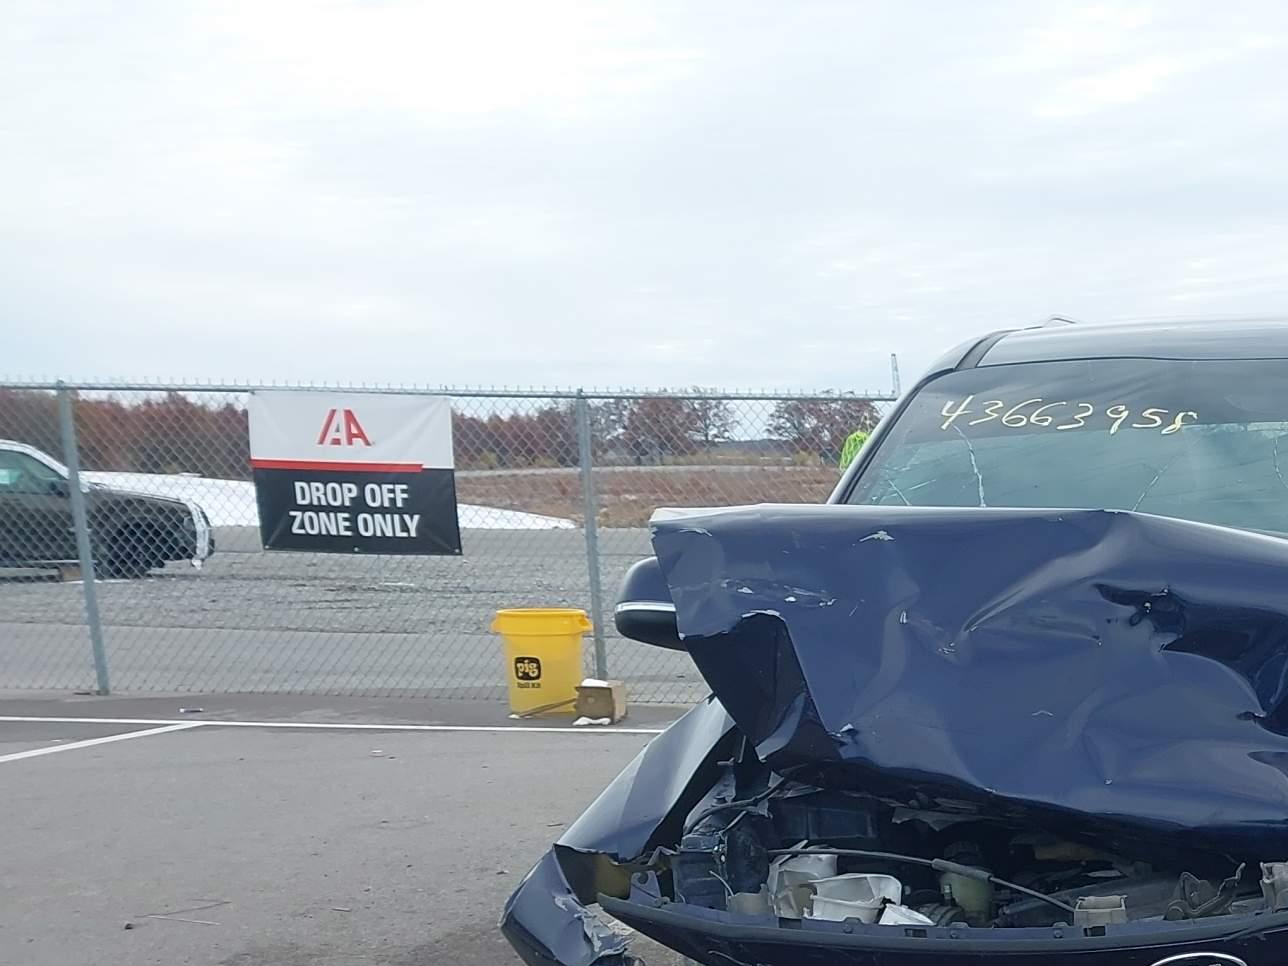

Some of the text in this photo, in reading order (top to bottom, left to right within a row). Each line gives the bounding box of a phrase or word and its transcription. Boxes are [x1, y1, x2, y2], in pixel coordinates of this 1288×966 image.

[940, 395, 1198, 435] 43663958
[294, 481, 409, 508] DROP OFF
[289, 511, 421, 538] ZONE ONLY
[516, 659, 539, 677] pig
